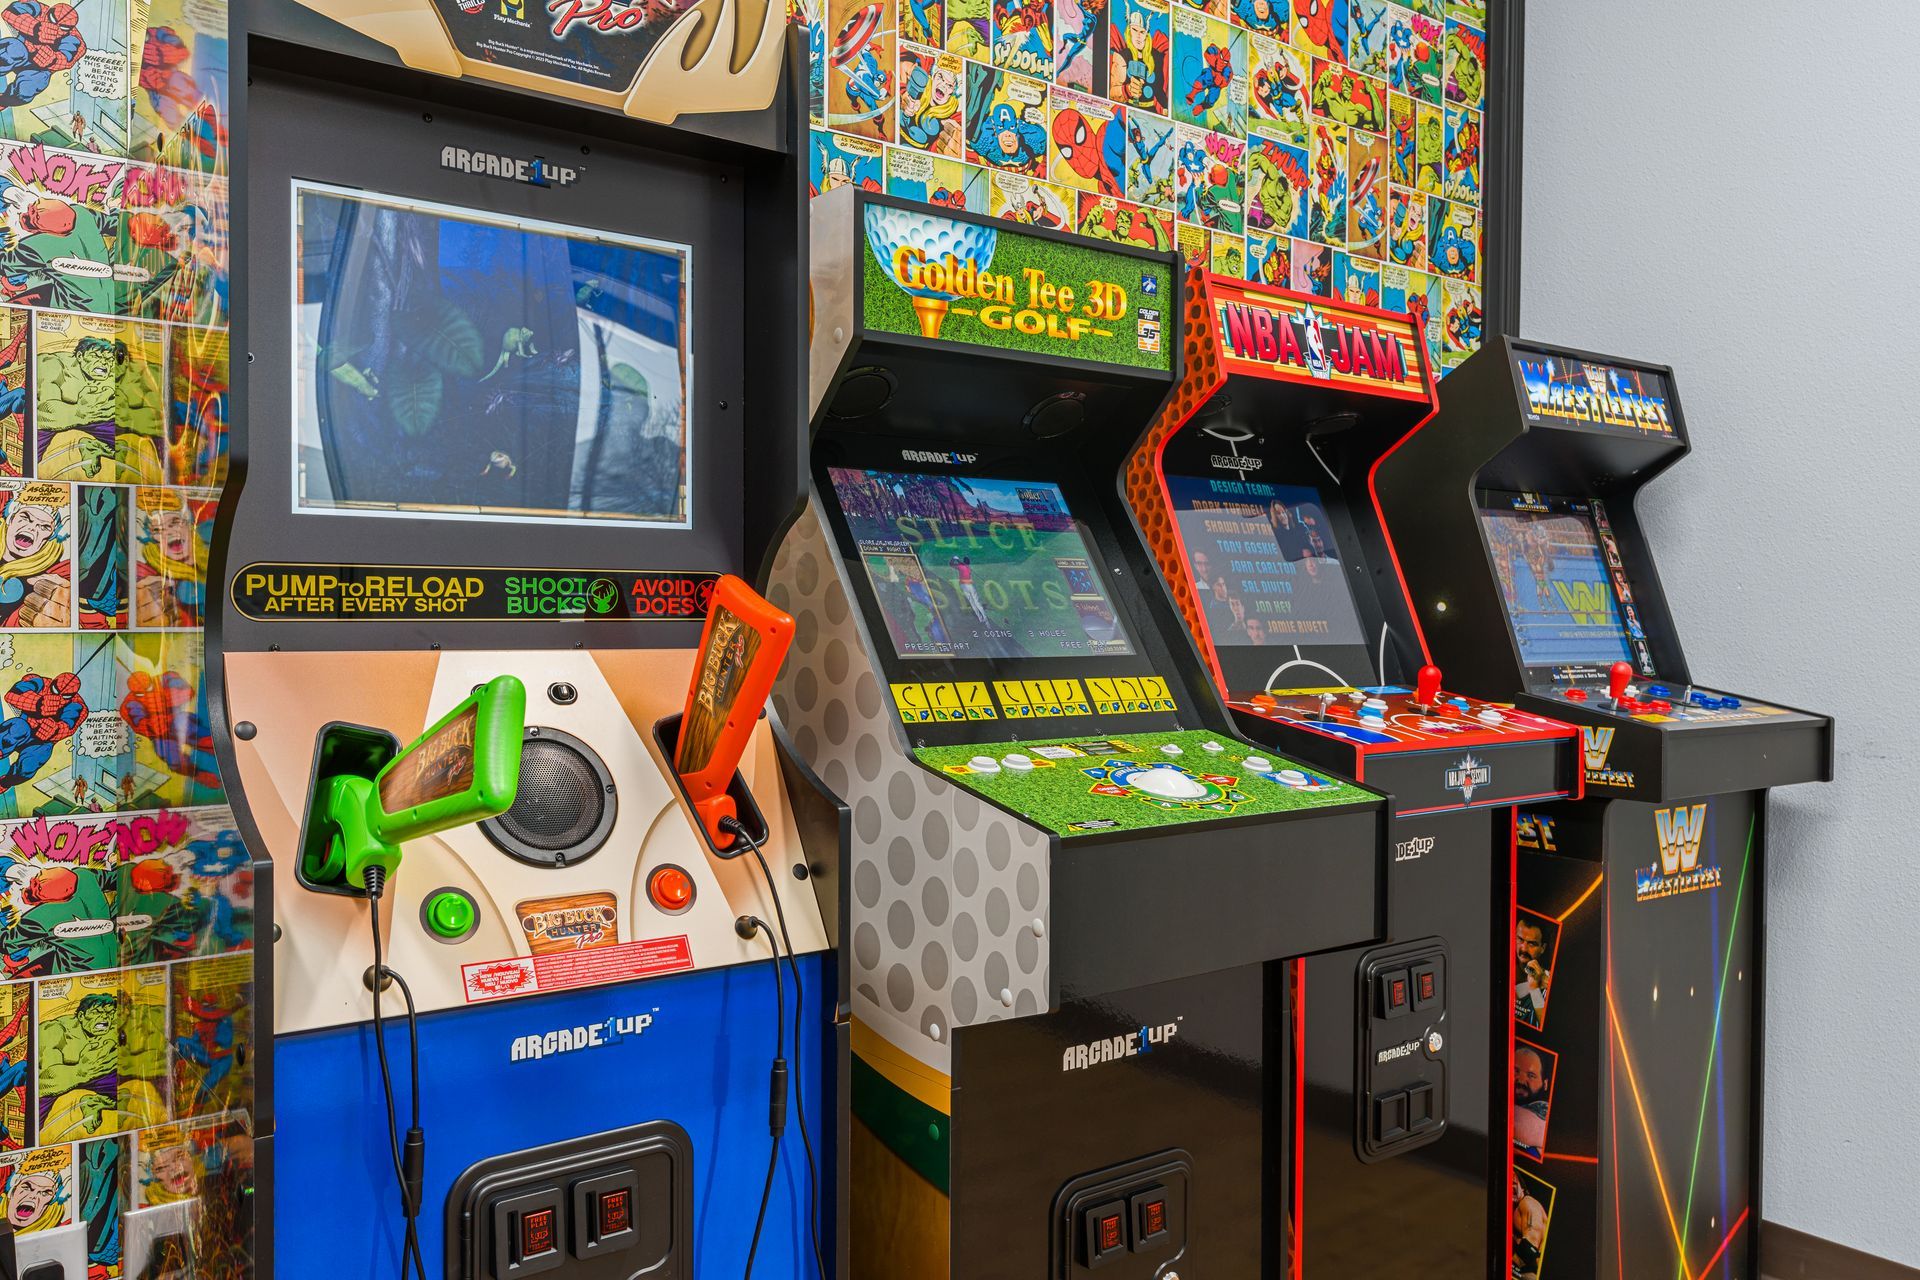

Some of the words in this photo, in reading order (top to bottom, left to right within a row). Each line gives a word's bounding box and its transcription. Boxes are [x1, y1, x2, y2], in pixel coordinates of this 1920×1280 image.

[494, 14, 506, 24] Play
[549, 0, 642, 35] Pro
[104, 64, 124, 72] SURE
[993, 41, 1054, 80] SHOOSH!
[84, 73, 118, 83] WAITING
[92, 68, 115, 76] BEATS
[93, 86, 116, 94] BUS!
[850, 144, 878, 153] THUNDER!
[8, 143, 125, 203] WOK!
[892, 245, 1015, 305] Golden
[1023, 268, 1075, 312] Tee
[1083, 280, 1128, 321] 3D
[1143, 328, 1155, 339] 35
[1226, 302, 1307, 367] NBA
[1330, 323, 1404, 384] JAM
[1210, 480, 1243, 493] DESIGN
[1245, 482, 1275, 496] TEAM:
[1192, 500, 1221, 513] MARK
[1223, 502, 1266, 517] TURMELL
[896, 516, 1046, 552] SLICE
[1205, 520, 1239, 534] SHAWN
[1217, 540, 1243, 553] TONY
[1244, 541, 1277, 555] GOSKIE
[1231, 560, 1253, 573] JOHN
[1255, 561, 1296, 575] CARLTON
[246, 574, 338, 596] PUMP
[338, 582, 364, 597] TO
[365, 576, 484, 598] RELOAD
[504, 577, 587, 595] SHOOT
[632, 579, 695, 596] AVOID
[1242, 580, 1259, 592] SAL
[1262, 580, 1293, 593] DIVITA
[265, 597, 334, 612] AFTER
[343, 598, 408, 612] EVERY
[414, 598, 468, 612] SHOT
[508, 596, 587, 614] BUCKS
[636, 598, 695, 615] DOES
[1256, 600, 1272, 613] JON
[1268, 620, 1297, 633] JAMIE
[1298, 620, 1328, 633] RIVETT
[716, 642, 736, 699] HUNTER
[530, 912, 562, 938] BIG
[563, 906, 612, 927] BUCK
[551, 924, 597, 937] HUNTER
[576, 931, 603, 949] Pro
[25, 1158, 67, 1172] JUSTICE!
[607, 1195, 623, 1204] FREE
[530, 1212, 547, 1222] FREE
[531, 1221, 547, 1229] PLAY
